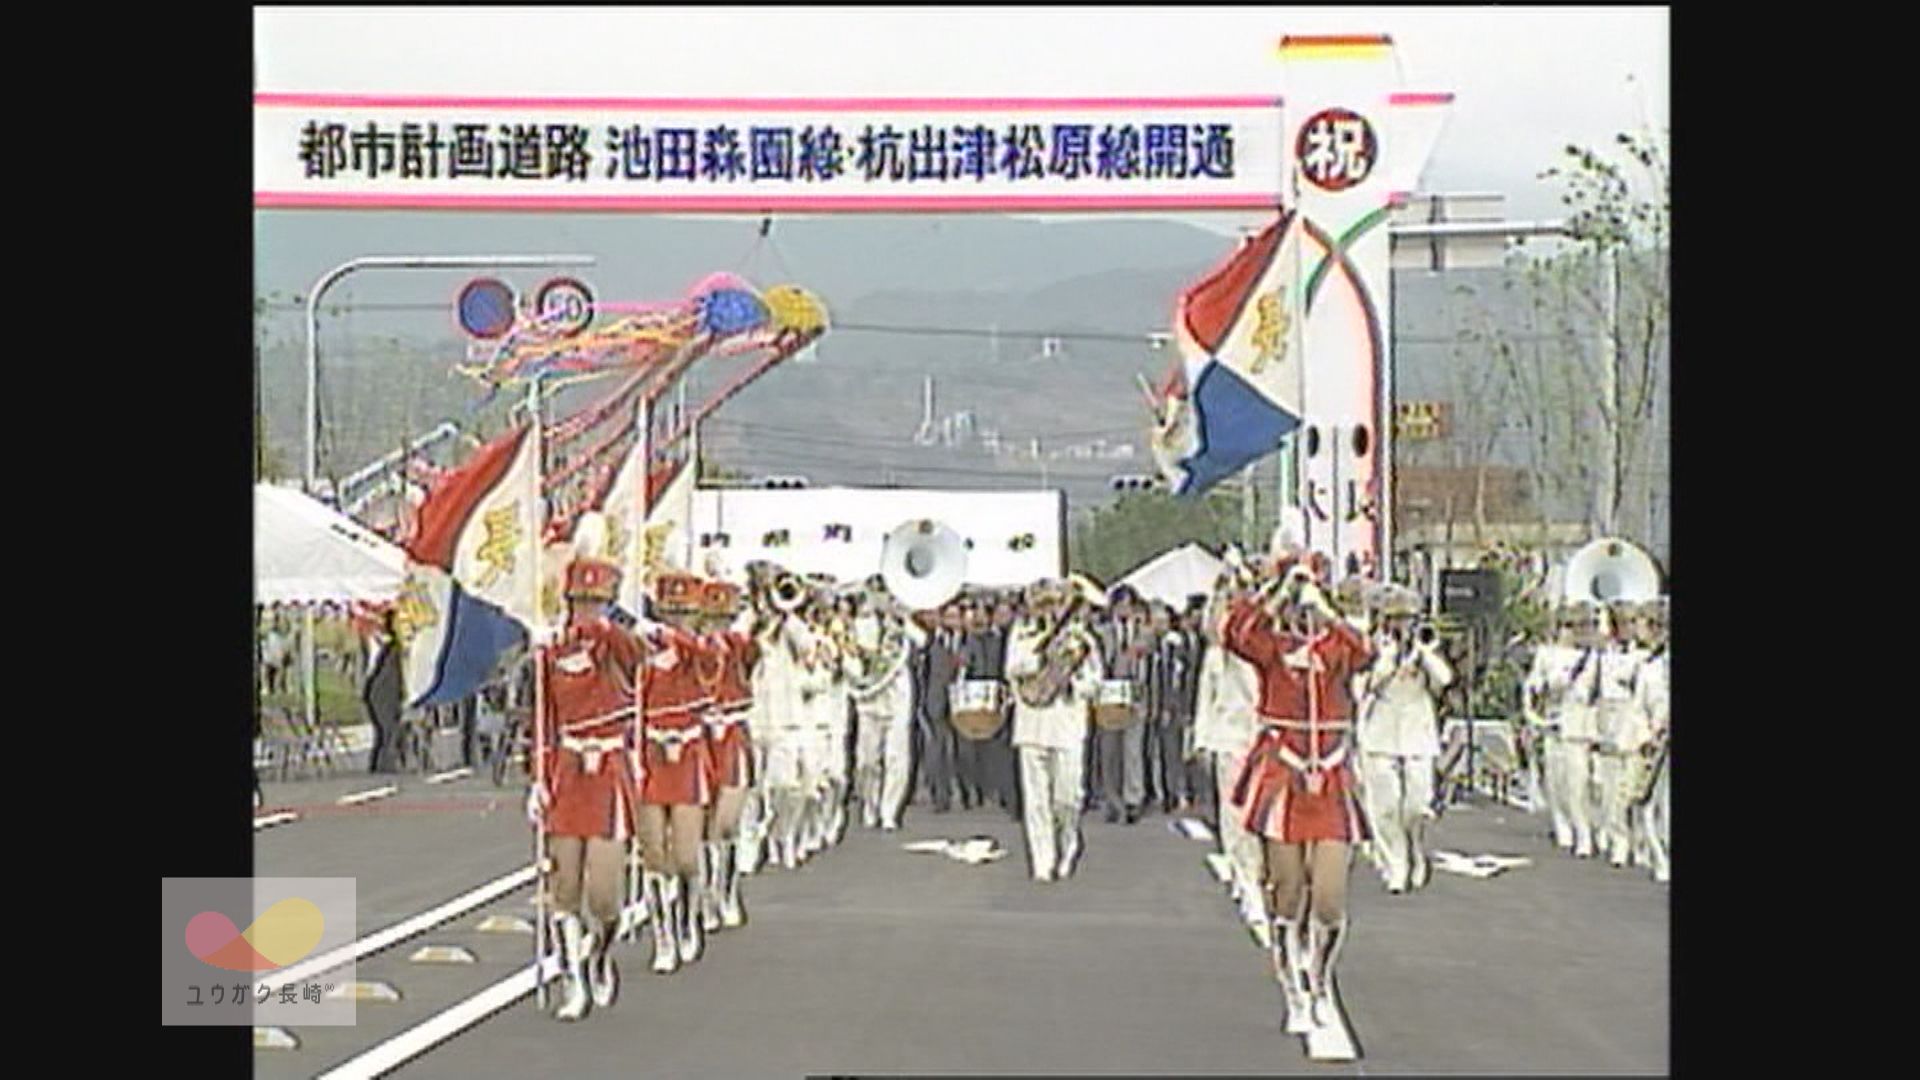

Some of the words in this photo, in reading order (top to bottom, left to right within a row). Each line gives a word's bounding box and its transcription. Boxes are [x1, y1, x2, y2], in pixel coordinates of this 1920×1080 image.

[299, 120, 592, 181] 都市計画道路
[1303, 117, 1368, 182] 祝
